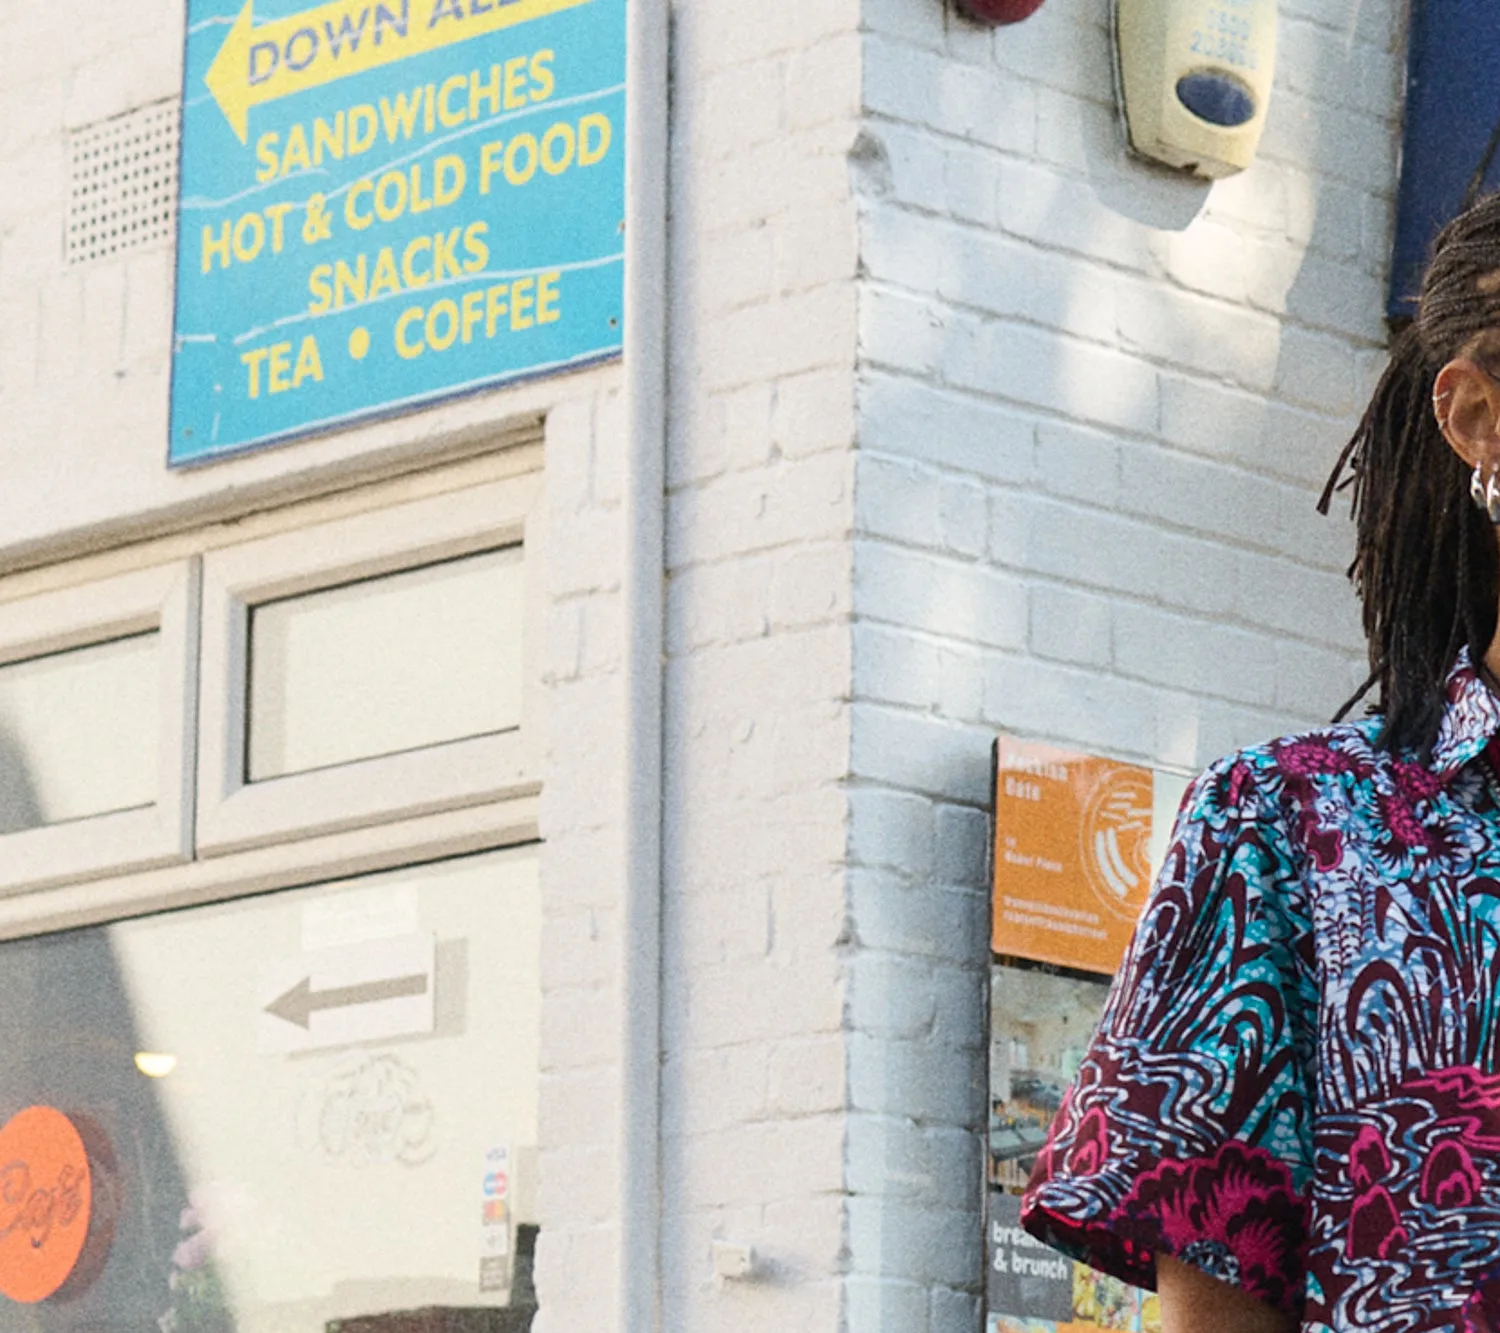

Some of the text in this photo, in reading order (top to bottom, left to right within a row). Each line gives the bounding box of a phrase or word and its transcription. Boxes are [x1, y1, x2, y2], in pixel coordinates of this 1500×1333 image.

[248, 0, 410, 87] DOWN
[256, 50, 555, 183] SANDWICHES
[202, 112, 612, 275] HOT & COLD FOOD
[308, 222, 490, 315] SNACKS
[241, 271, 562, 401] TEA COFFEE
[994, 1247, 1068, 1280] & brunch
